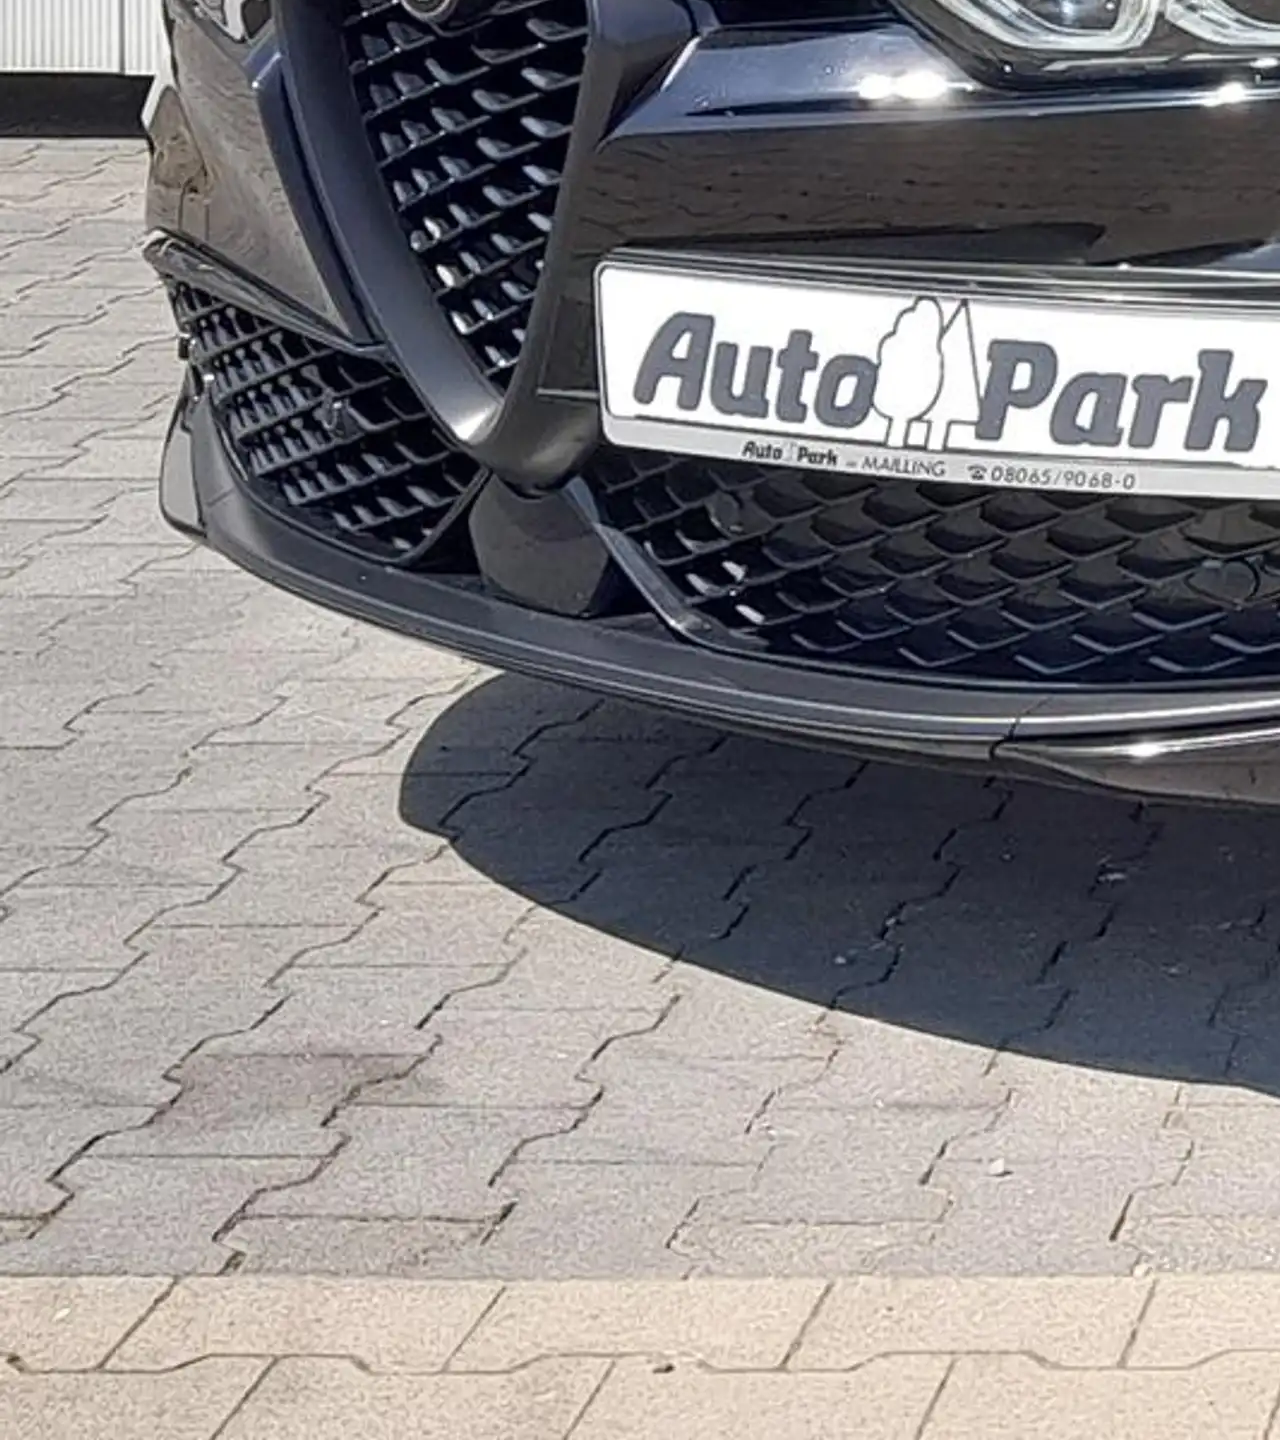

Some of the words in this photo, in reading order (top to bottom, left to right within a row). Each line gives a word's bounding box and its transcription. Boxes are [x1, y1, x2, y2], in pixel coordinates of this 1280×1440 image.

[632, 311, 879, 429] Auto
[975, 339, 1268, 452] Park
[742, 441, 783, 460] Auto
[798, 446, 839, 466] Park
